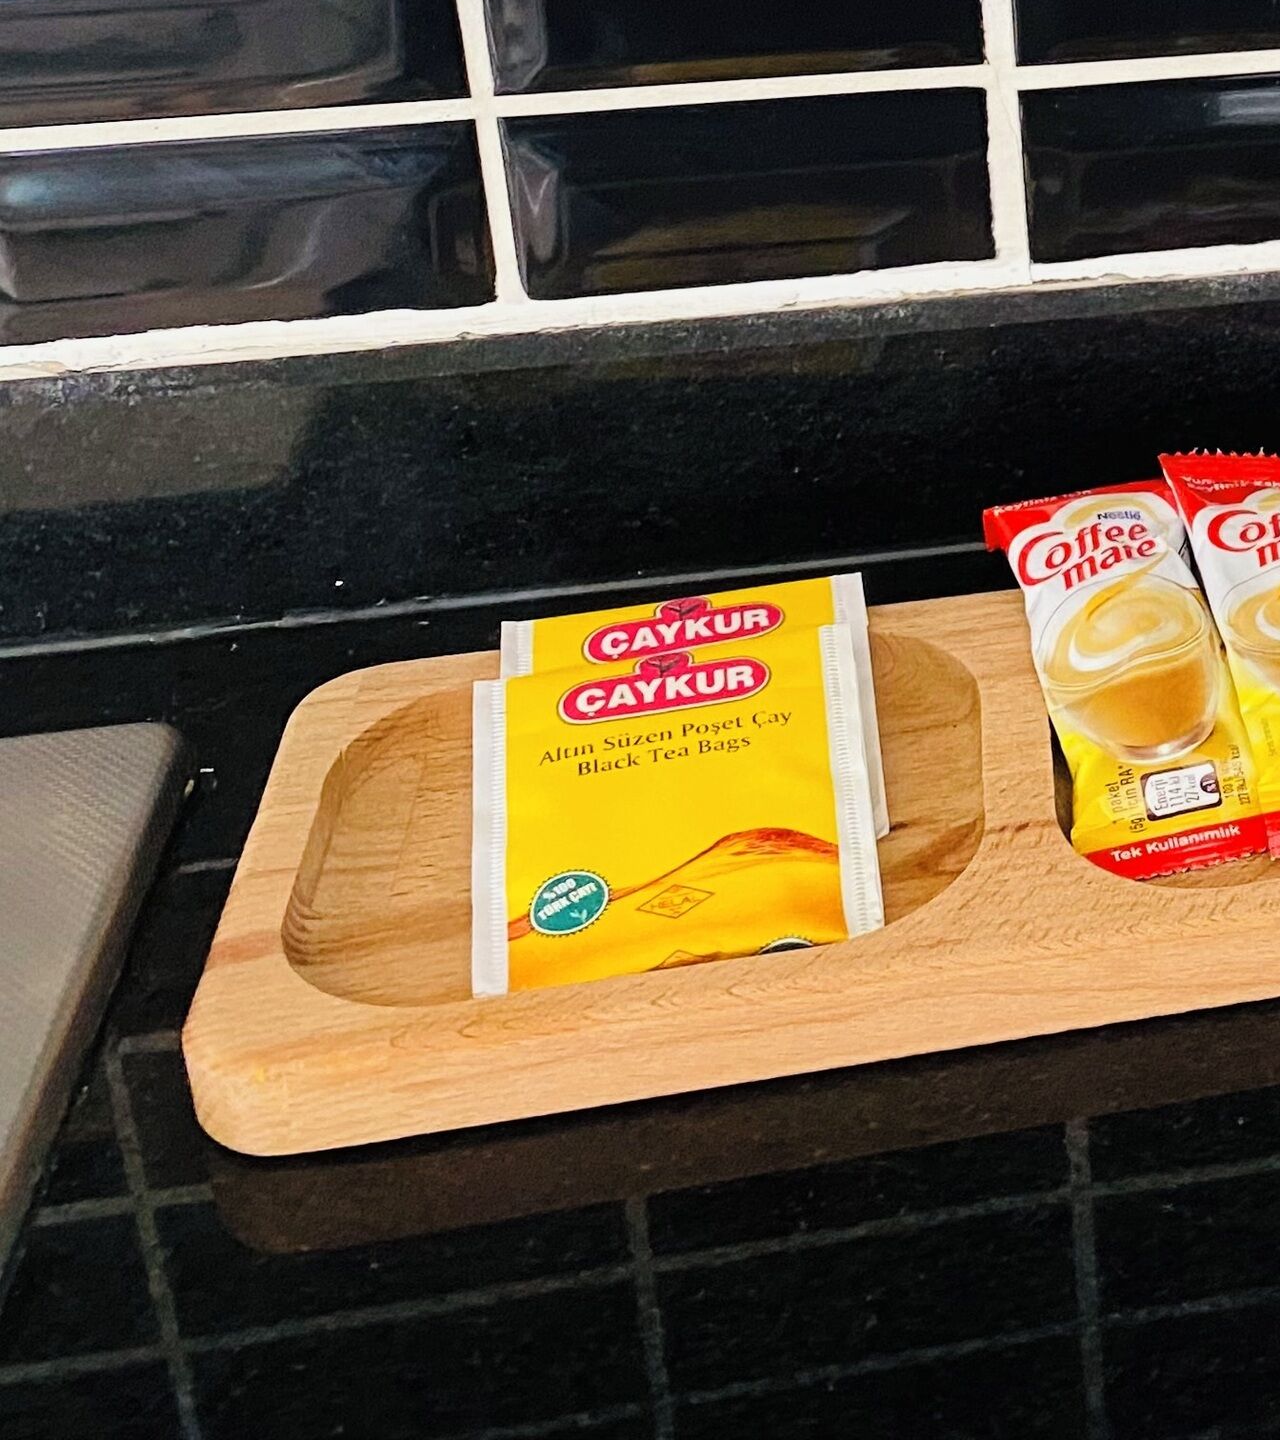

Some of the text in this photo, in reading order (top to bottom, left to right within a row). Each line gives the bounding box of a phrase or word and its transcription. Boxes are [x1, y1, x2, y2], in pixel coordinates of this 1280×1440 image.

[1018, 522, 1148, 587] Coffee
[1061, 539, 1157, 591] mate
[600, 609, 771, 659] ÇAYKUR
[575, 665, 756, 718] ÇAYKUR
[538, 710, 792, 766] Altın Süzen Poşet Çay
[578, 736, 751, 776] Black Tea Bags
[1185, 792, 1199, 804] 27
[1111, 824, 1242, 862] Tek Kullanımlık
